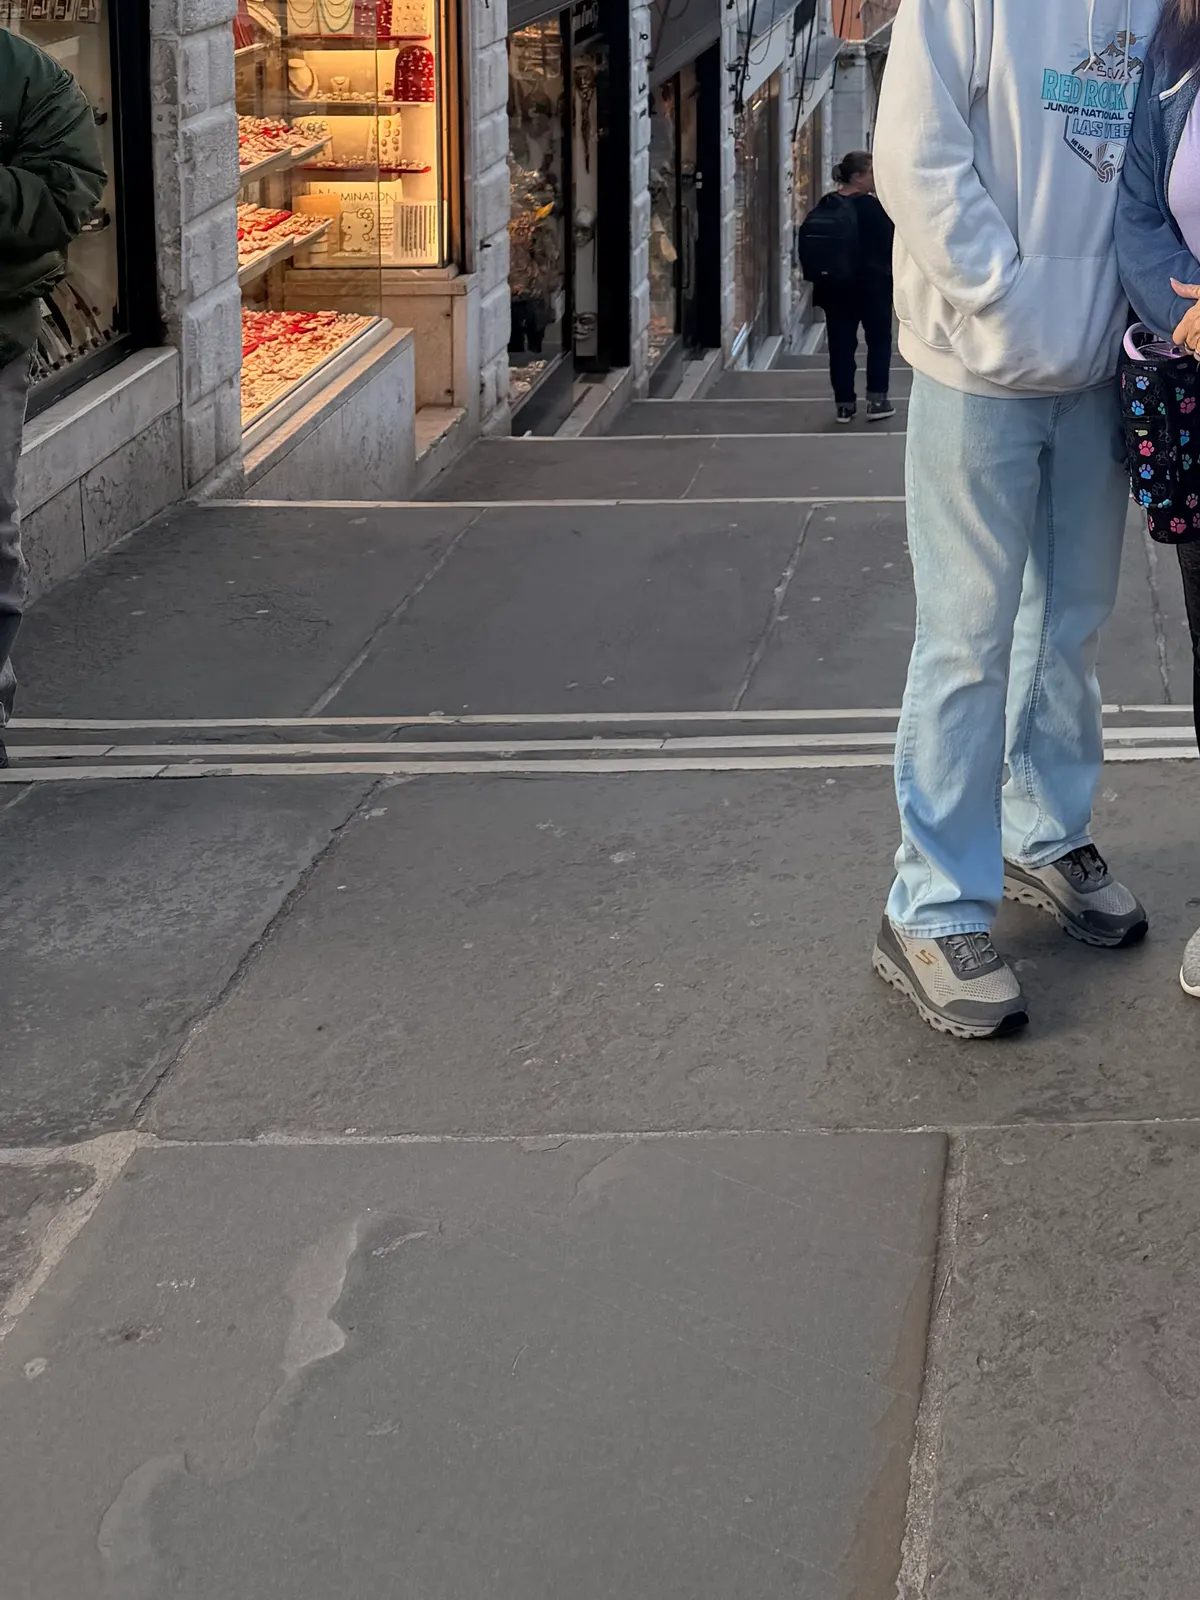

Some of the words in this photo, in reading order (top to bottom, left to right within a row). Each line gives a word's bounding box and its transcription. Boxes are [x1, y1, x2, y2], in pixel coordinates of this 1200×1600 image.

[1041, 68, 1083, 105] RED
[1044, 102, 1080, 116] JUNIOR
[1071, 118, 1103, 138] LAS
[1104, 122, 1132, 139] VEG
[1070, 138, 1093, 160] NEVADA
[319, 189, 397, 205] MINATION
